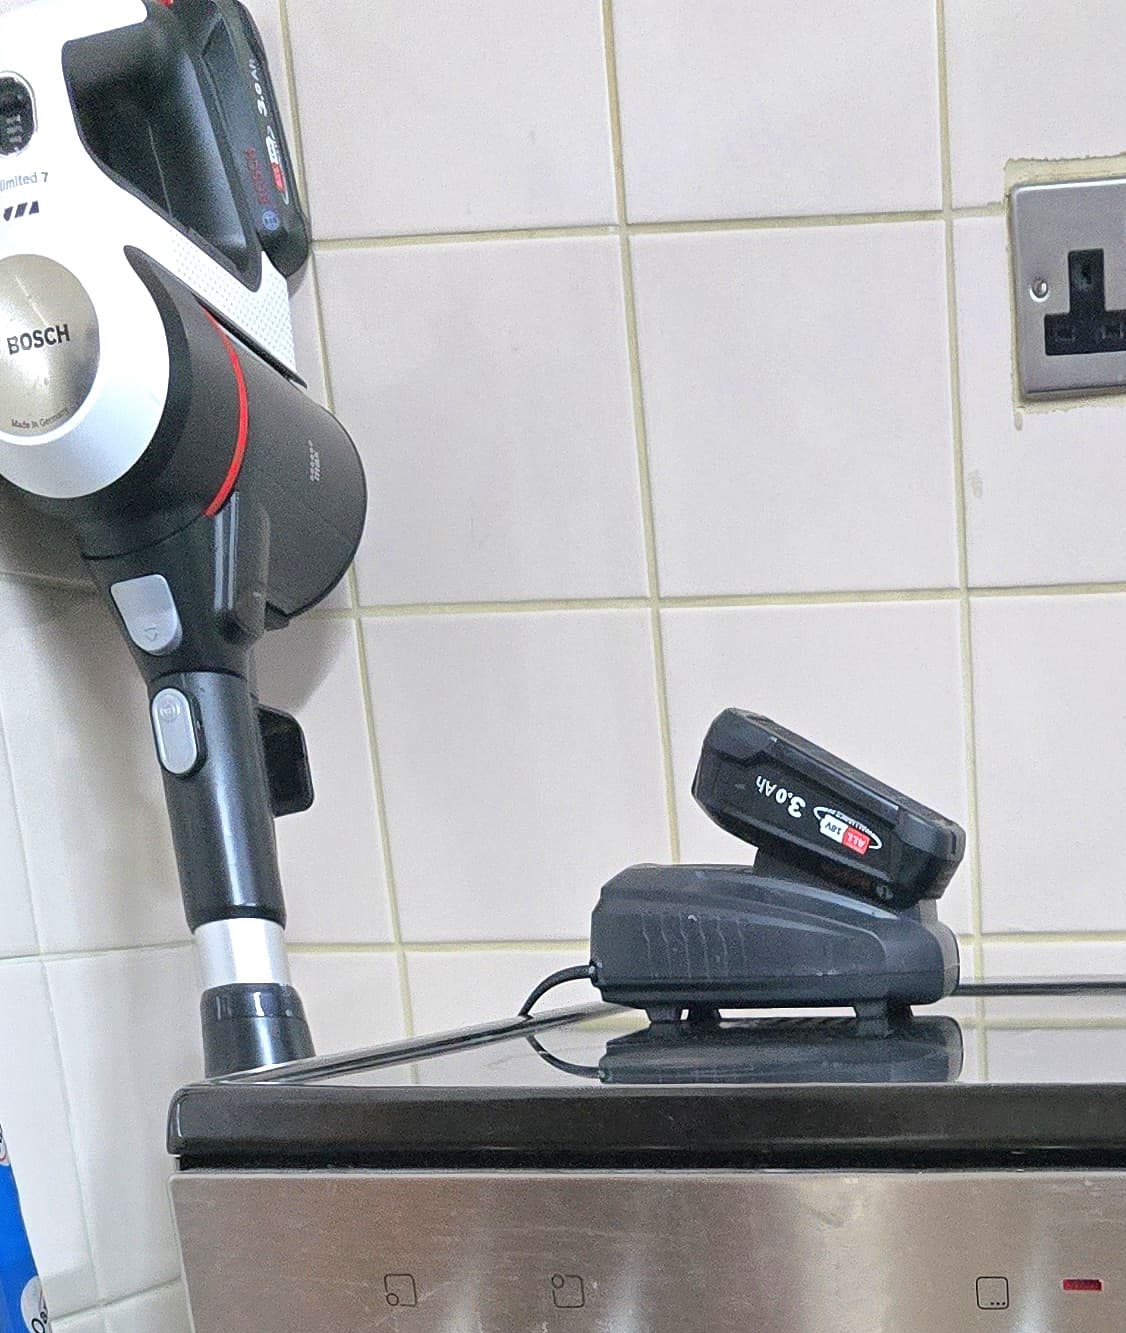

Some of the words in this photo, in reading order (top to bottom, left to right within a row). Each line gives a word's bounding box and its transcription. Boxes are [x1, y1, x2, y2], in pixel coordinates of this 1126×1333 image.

[41, 171, 49, 182] 7
[7, 324, 70, 355] BOSCH
[756, 775, 778, 797] Ah
[775, 788, 806, 818] 3.0
[824, 821, 842, 836] 18V
